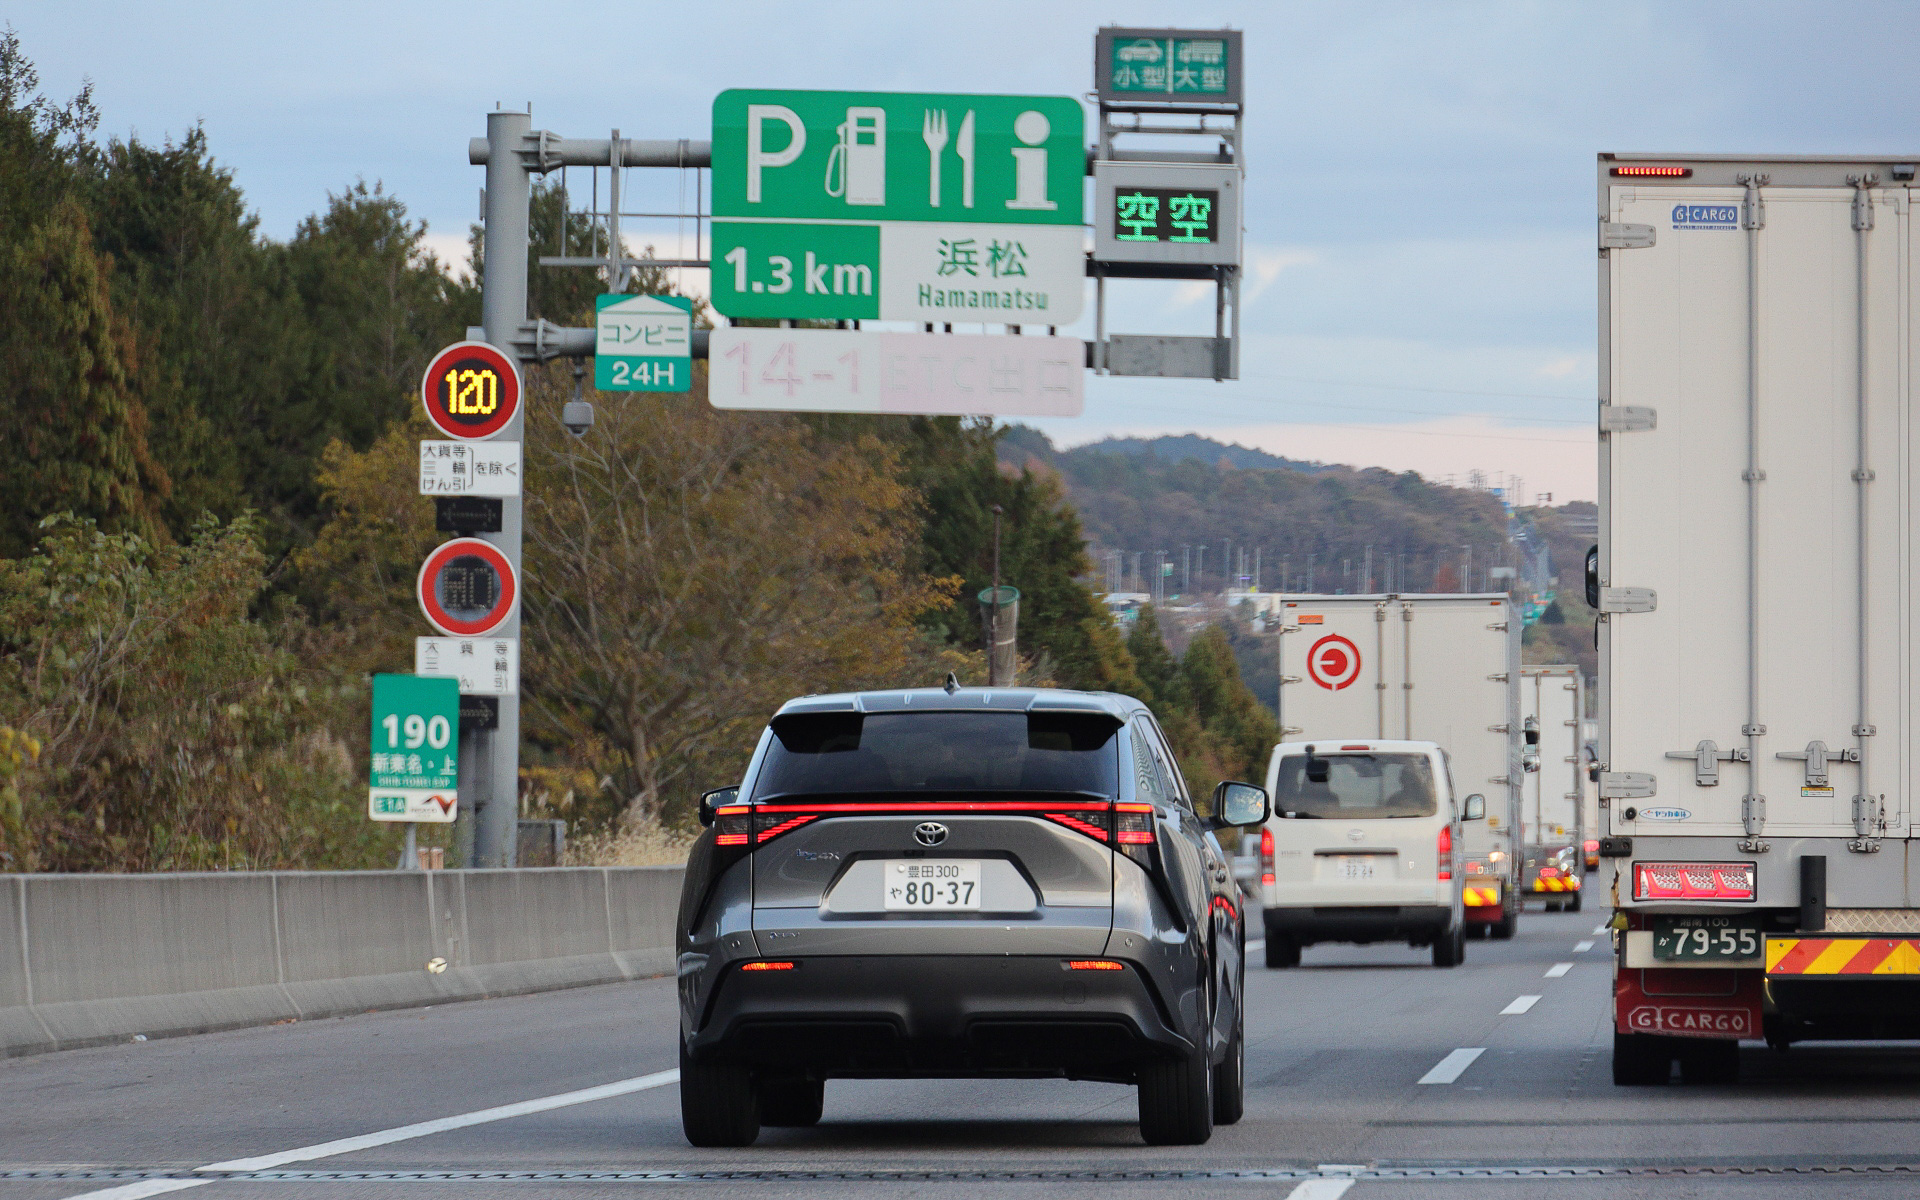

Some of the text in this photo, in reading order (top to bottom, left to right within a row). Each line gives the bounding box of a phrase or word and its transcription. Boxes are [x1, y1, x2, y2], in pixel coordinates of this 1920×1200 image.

[1113, 65, 1226, 91] 小型 大型
[1116, 192, 1211, 244] 空 空
[724, 246, 873, 296] 1.3 km
[936, 238, 1029, 279] 浜松
[917, 283, 1049, 311] Hamamatsu
[602, 323, 686, 346] コンビニ
[611, 360, 675, 387] 24H
[724, 341, 863, 397] 14-1
[445, 368, 497, 415] 120
[423, 444, 467, 459] 大貨等
[475, 461, 517, 477] を除く
[423, 477, 466, 492] けん引
[382, 713, 451, 750] 190
[906, 881, 975, 905] 80-37
[1673, 928, 1757, 955] 79-55
